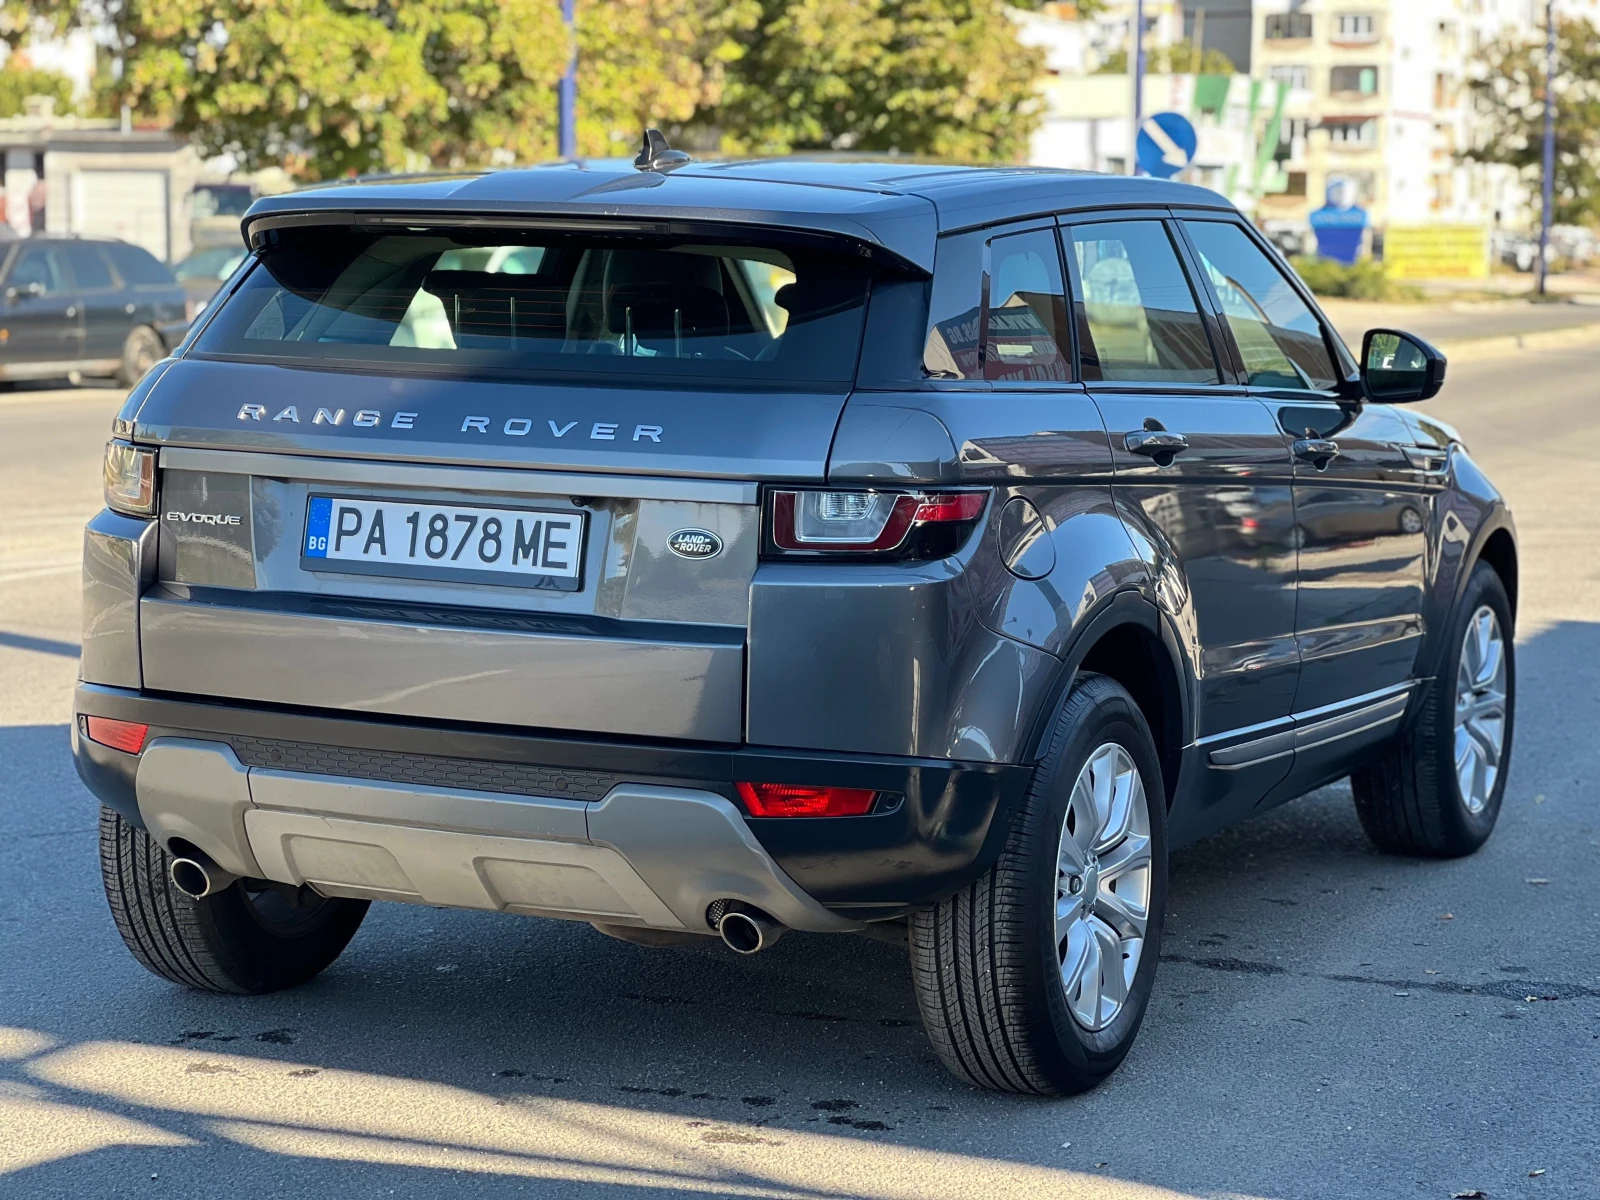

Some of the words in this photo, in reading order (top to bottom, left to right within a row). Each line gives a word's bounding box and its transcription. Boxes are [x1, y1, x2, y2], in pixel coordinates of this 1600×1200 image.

[236, 403, 419, 430] RANGE
[460, 416, 664, 443] ROVER
[166, 511, 241, 526] EVOQUE
[308, 535, 327, 552] BG
[334, 506, 387, 555] PA
[406, 511, 503, 563] 1878
[511, 518, 571, 569] ME
[677, 534, 705, 544] LAND
[679, 542, 712, 553] ROVER
